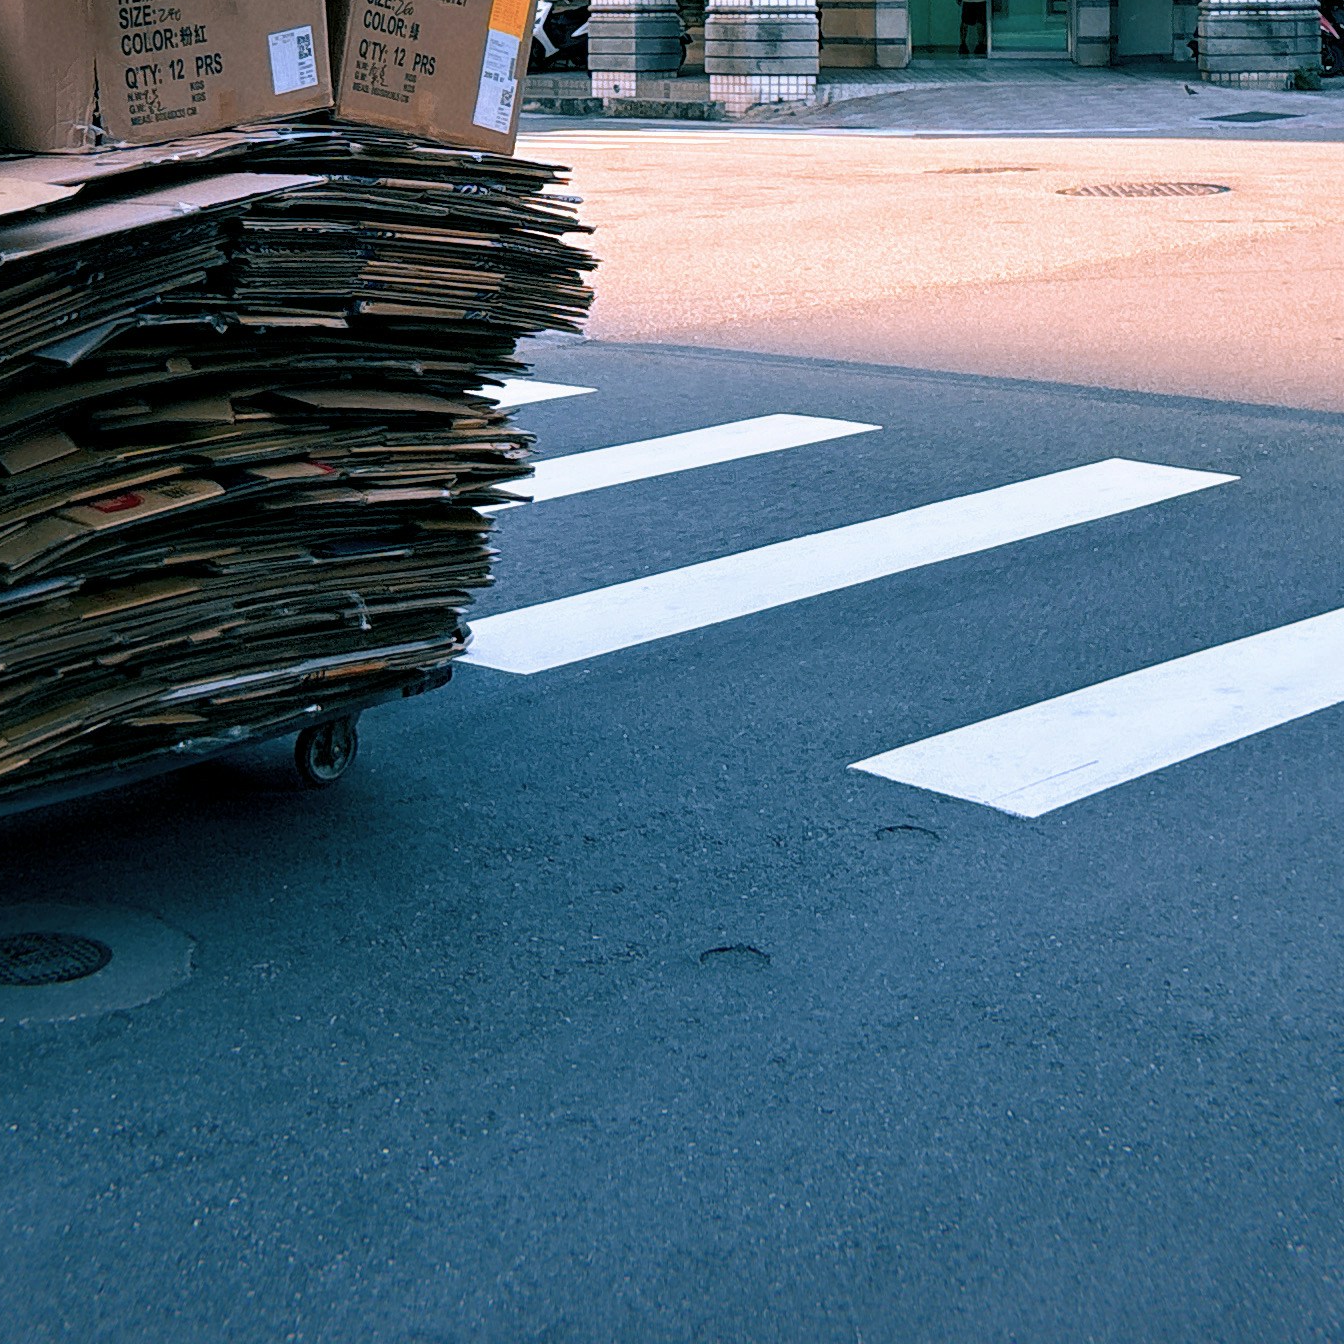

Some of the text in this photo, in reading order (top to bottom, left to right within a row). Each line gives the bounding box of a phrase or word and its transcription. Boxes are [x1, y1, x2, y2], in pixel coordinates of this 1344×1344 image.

[119, 5, 156, 30] SIZE:
[363, 9, 407, 38] COLOR:
[121, 24, 208, 56] COLOR: 粉紅
[125, 52, 223, 90] Q'TY: 12 PRS
[359, 38, 389, 64] Q'TY:
[394, 46, 406, 67] 12
[412, 52, 436, 76] PRS
